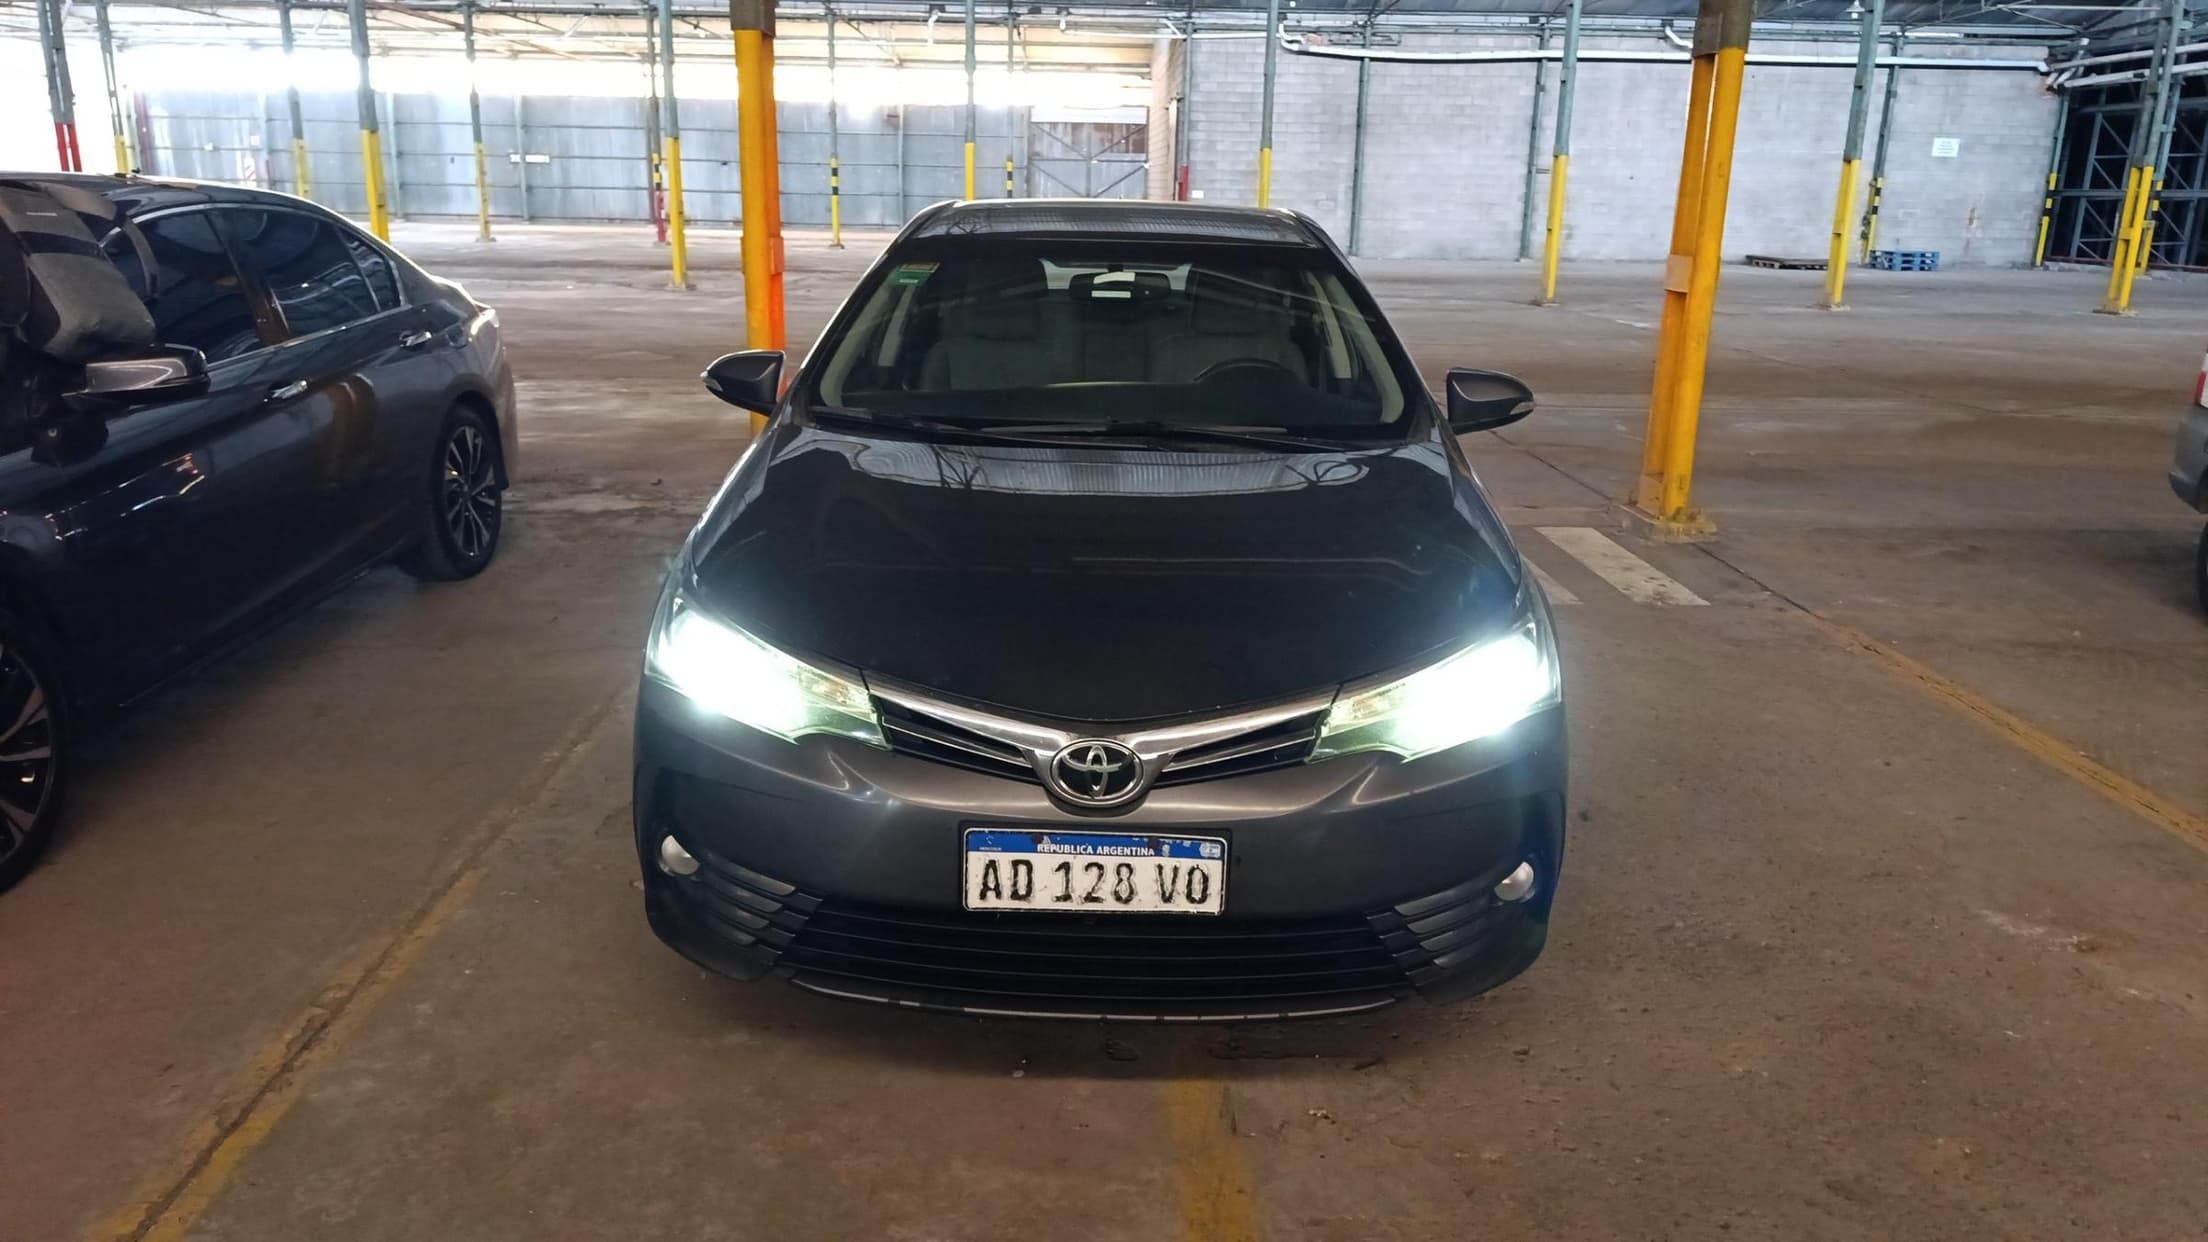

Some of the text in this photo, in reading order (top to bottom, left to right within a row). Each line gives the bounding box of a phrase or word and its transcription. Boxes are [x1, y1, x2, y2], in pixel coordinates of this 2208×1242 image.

[1096, 845, 1155, 856] ARGENTINA
[979, 859, 1210, 905] AD 128 VO
